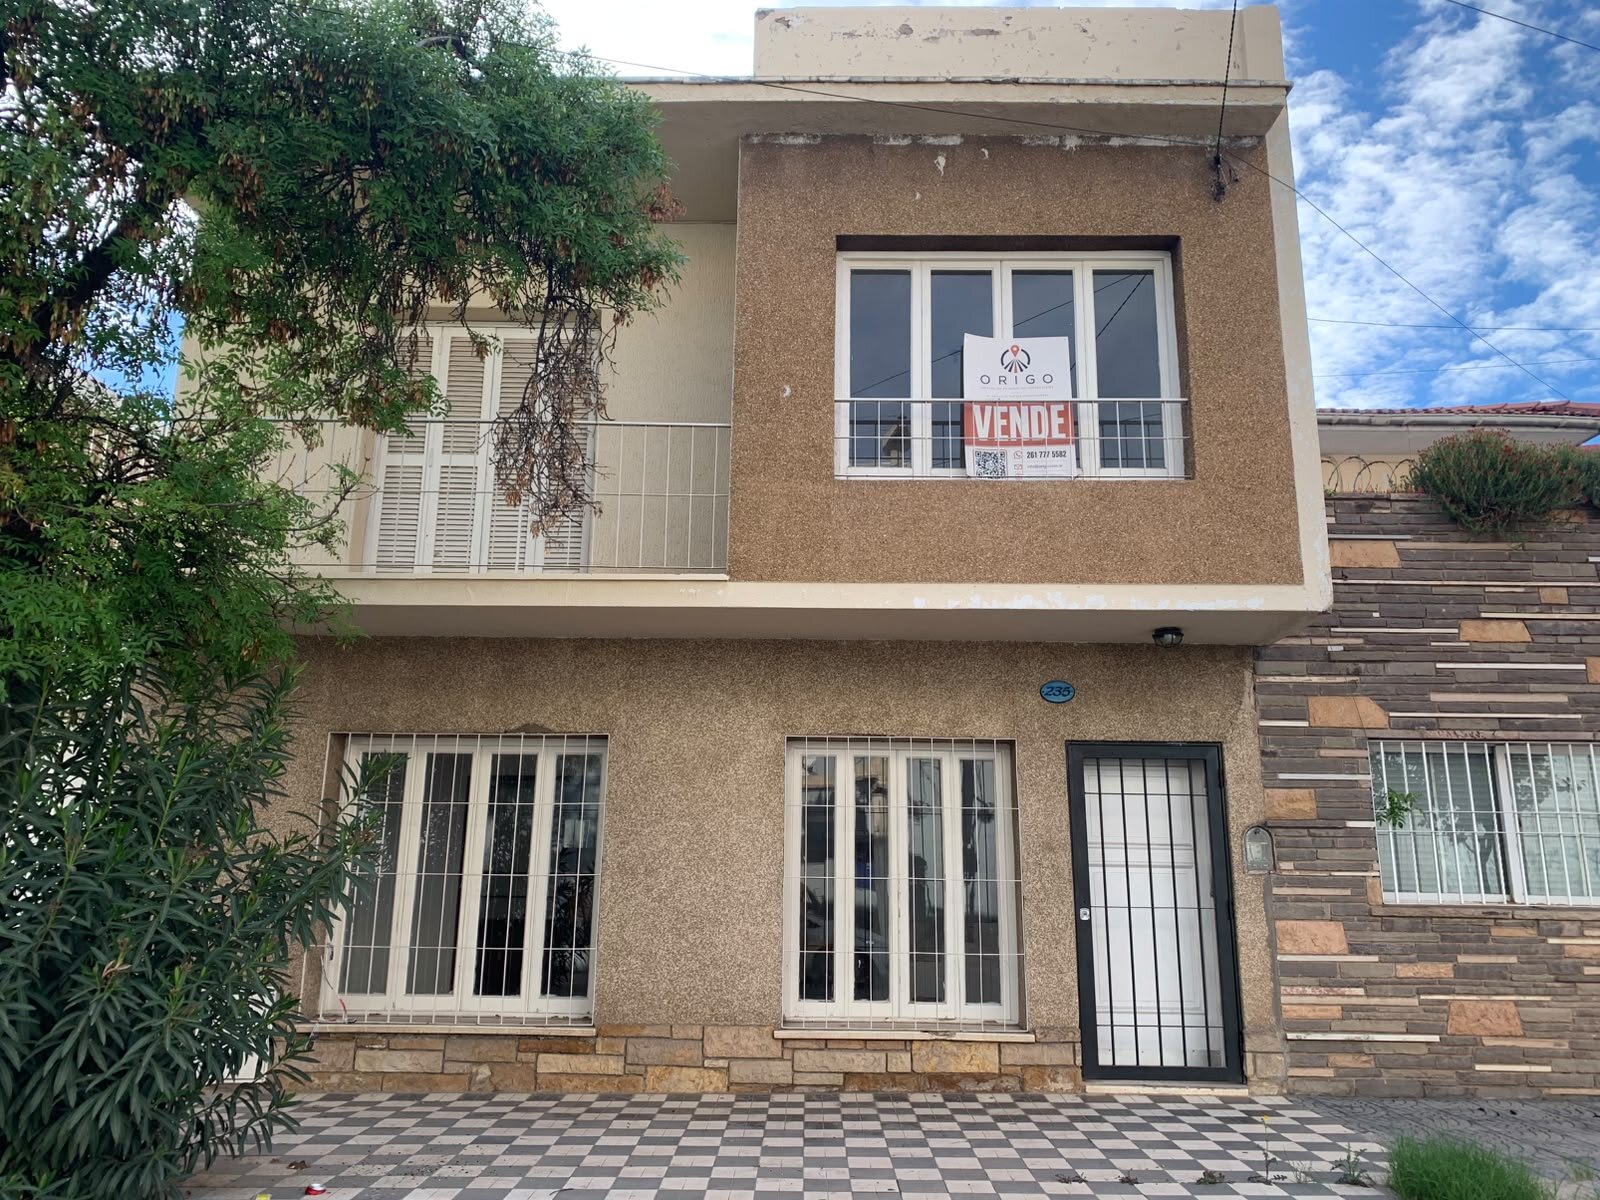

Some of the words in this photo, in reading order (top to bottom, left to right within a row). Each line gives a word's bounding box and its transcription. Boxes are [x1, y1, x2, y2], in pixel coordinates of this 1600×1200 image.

[980, 374, 1053, 385] ORIGO
[973, 404, 1066, 441] VENDE
[1026, 451, 1037, 459] 261
[1039, 450, 1050, 458] 777
[1044, 686, 1071, 697] 235
